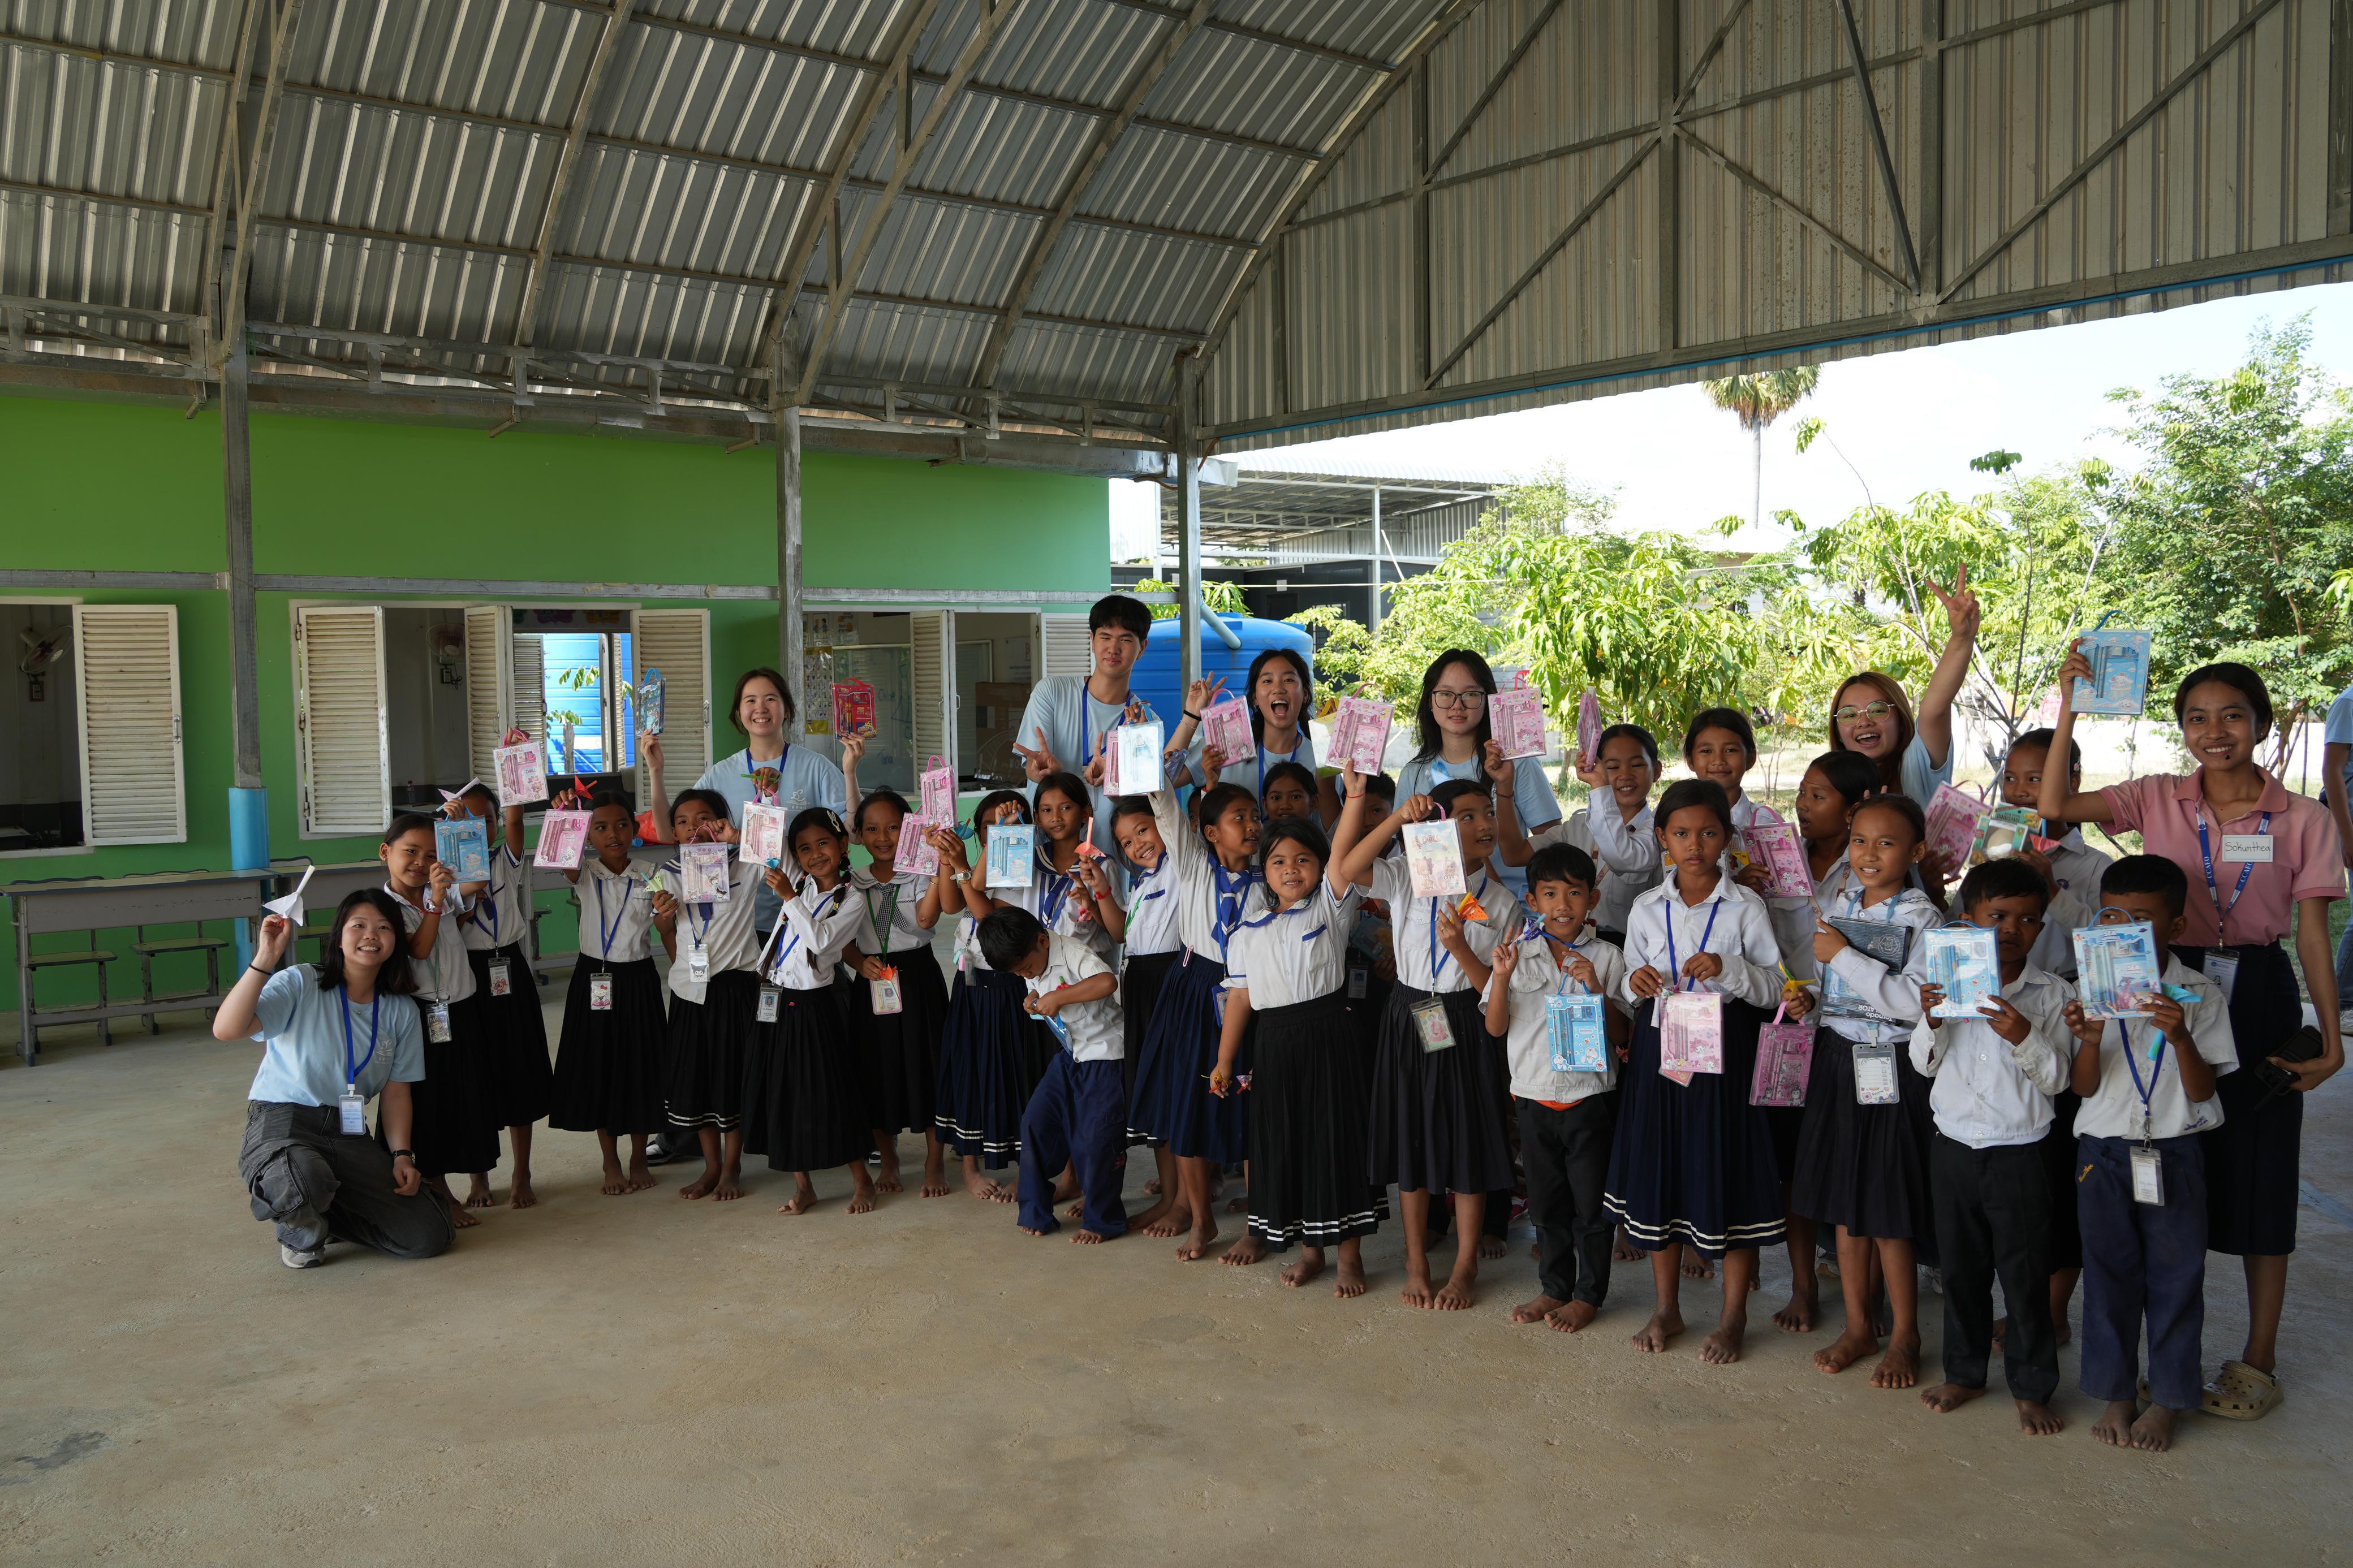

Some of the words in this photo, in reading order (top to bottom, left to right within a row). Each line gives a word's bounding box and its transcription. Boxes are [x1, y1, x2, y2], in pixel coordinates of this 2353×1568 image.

[1421, 834, 1441, 844] DOLL
[2225, 841, 2271, 852] Sokunthea
[2204, 856, 2213, 879] CCAFO
